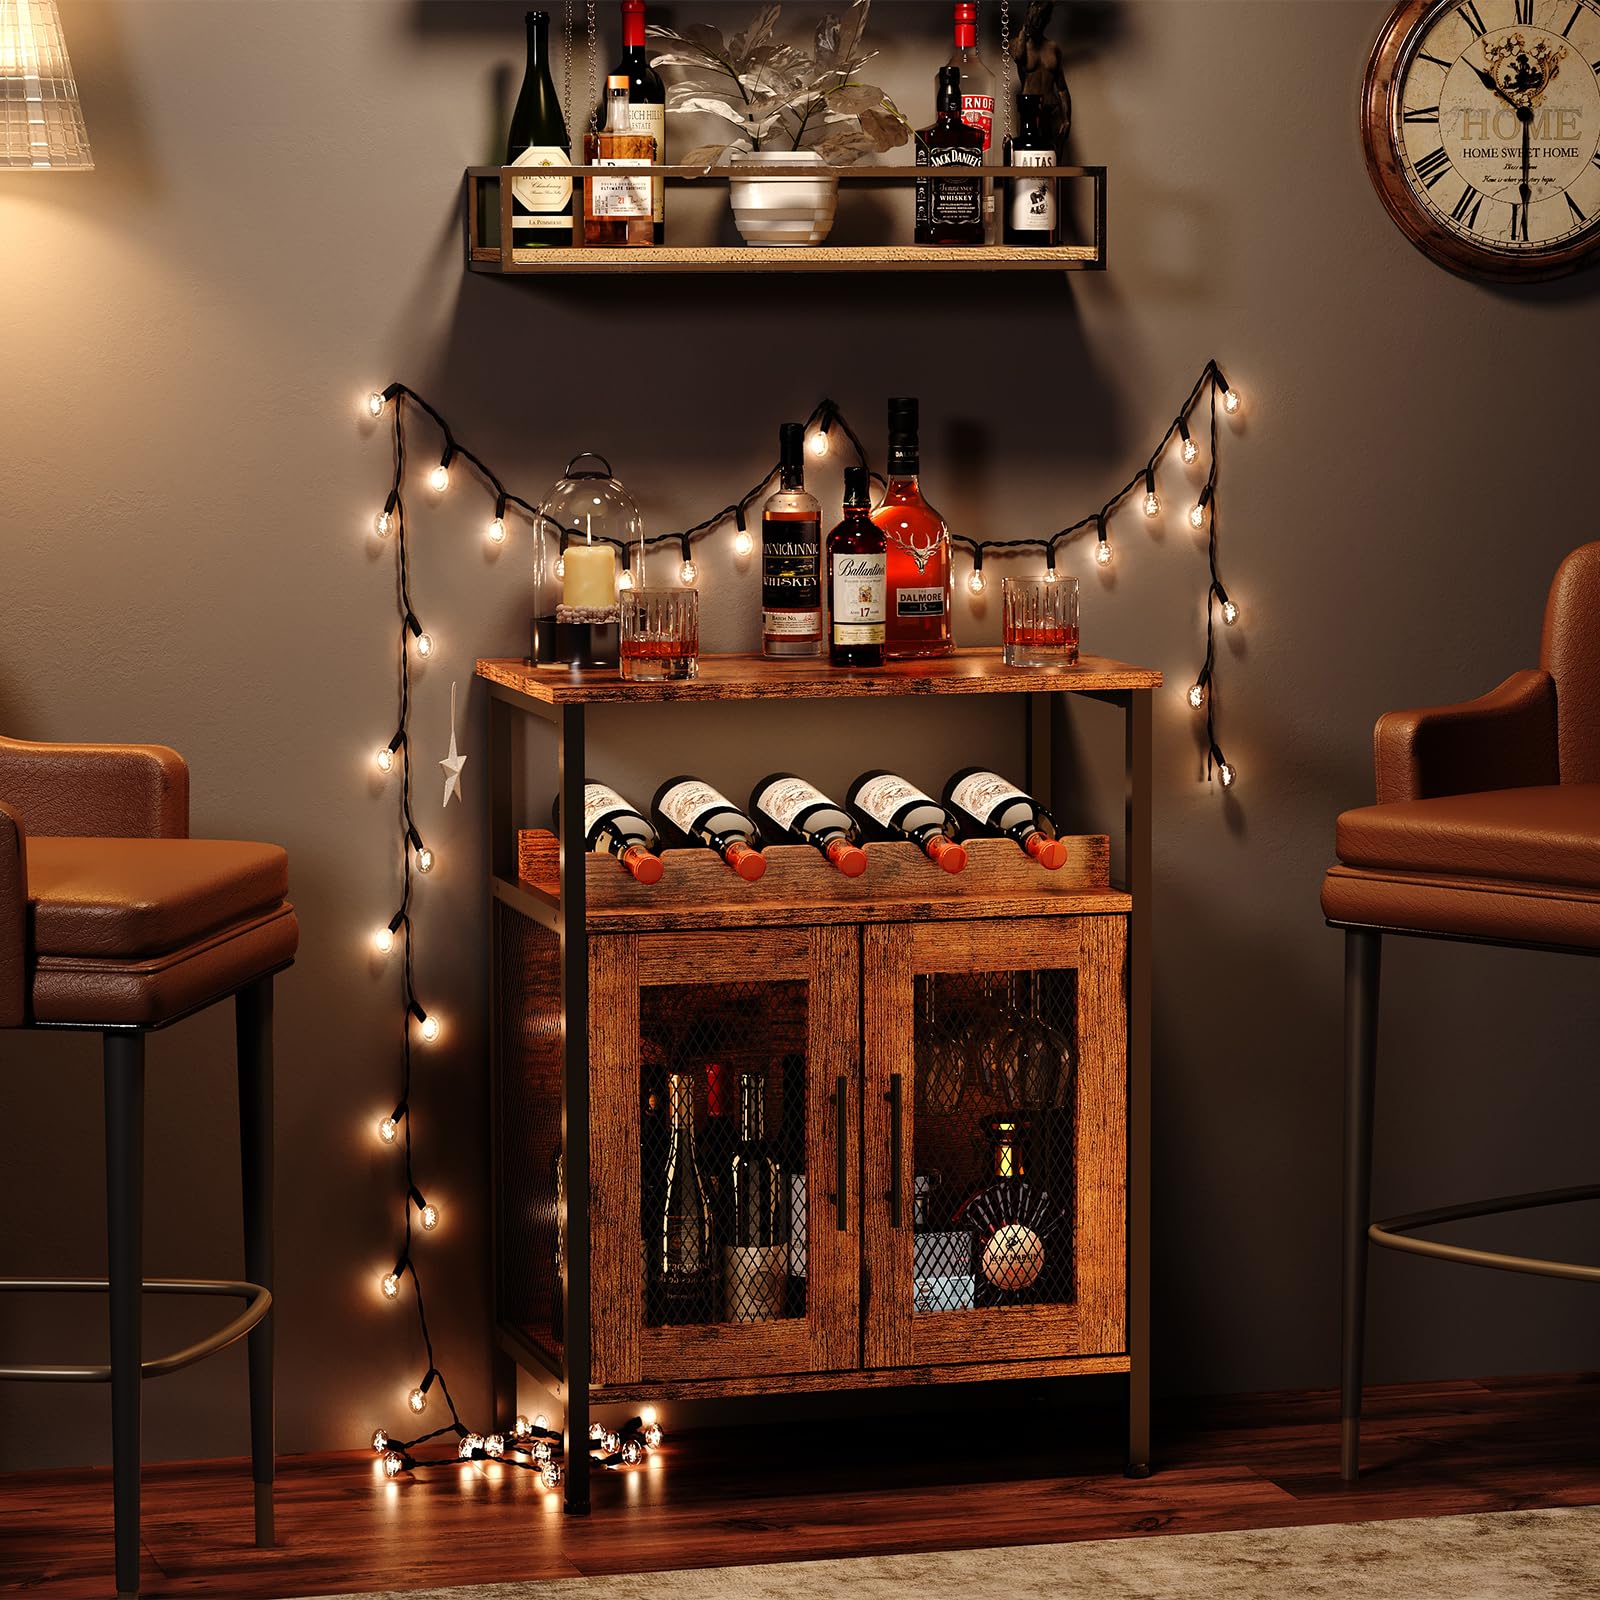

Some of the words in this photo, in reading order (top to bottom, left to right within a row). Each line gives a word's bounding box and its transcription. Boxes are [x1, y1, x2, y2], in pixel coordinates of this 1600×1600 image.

[1461, 108, 1582, 140] HOME
[1463, 148, 1499, 158] HOME
[1543, 147, 1579, 158] HOME
[930, 153, 951, 167] JACK
[900, 593, 942, 602] DALMORE
[860, 607, 870, 617] 17
